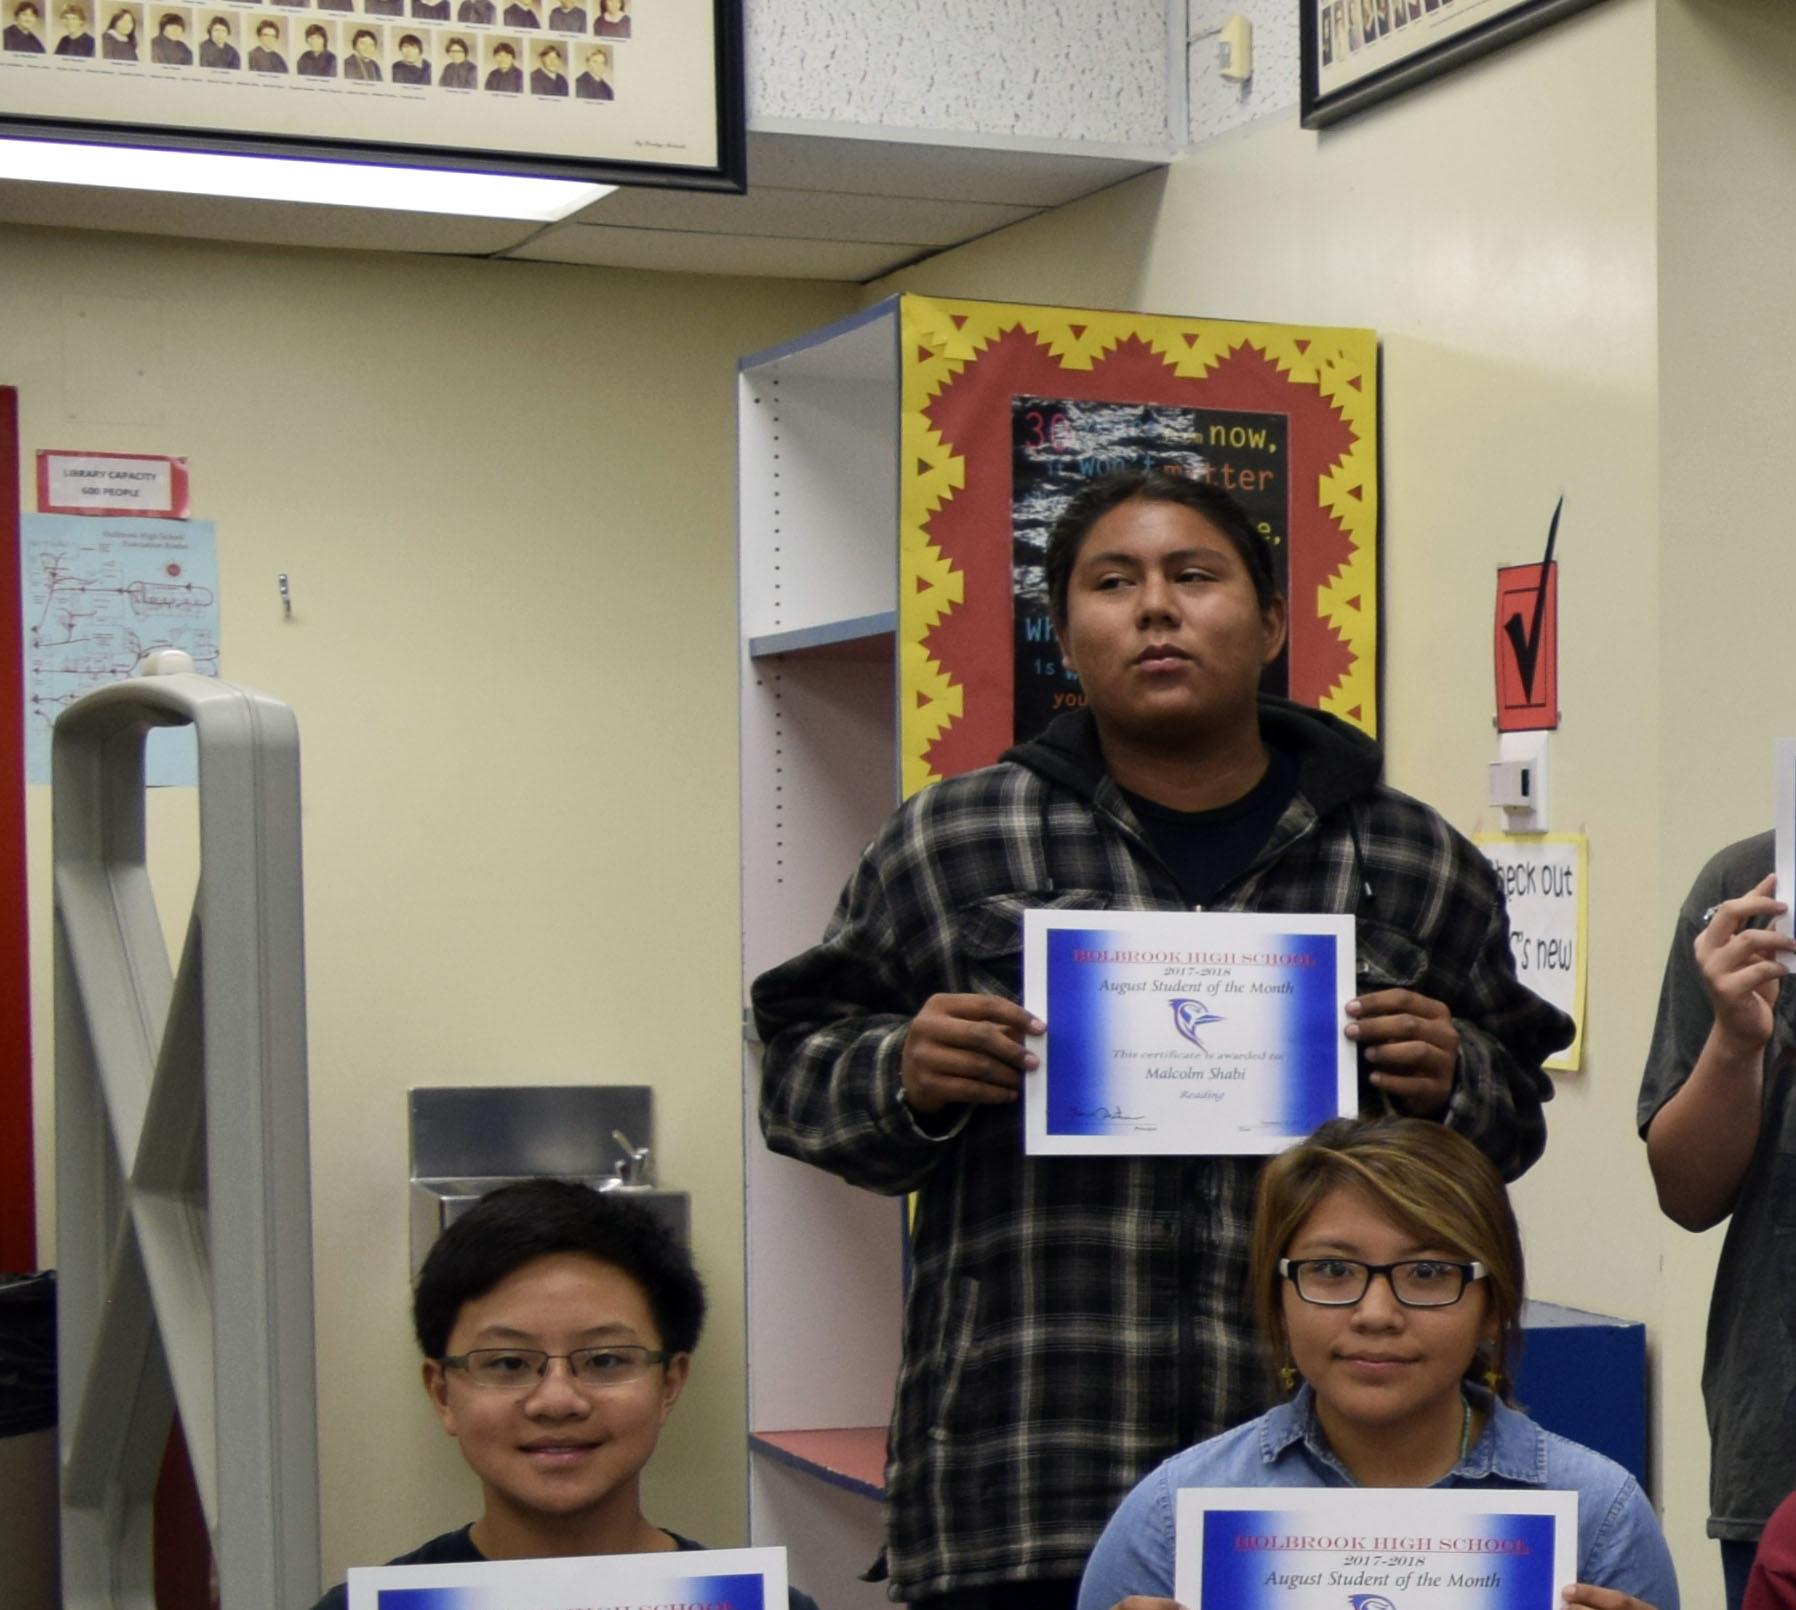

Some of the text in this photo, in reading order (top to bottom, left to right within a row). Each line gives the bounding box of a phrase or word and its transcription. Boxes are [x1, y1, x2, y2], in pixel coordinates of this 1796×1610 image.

[1209, 424, 1277, 454] now,
[1496, 860, 1573, 898] heck out
[1187, 951, 1236, 963] HIGH
[1537, 937, 1573, 972] new
[1162, 966, 1232, 977] 2017-2018
[1098, 978, 1295, 996] August Student of the Month
[1236, 1534, 1529, 1552] HOLBROOK HIGH SCHOOL
[1342, 1554, 1426, 1567] 2017-2018
[1263, 1569, 1502, 1591] August Student of the Month
